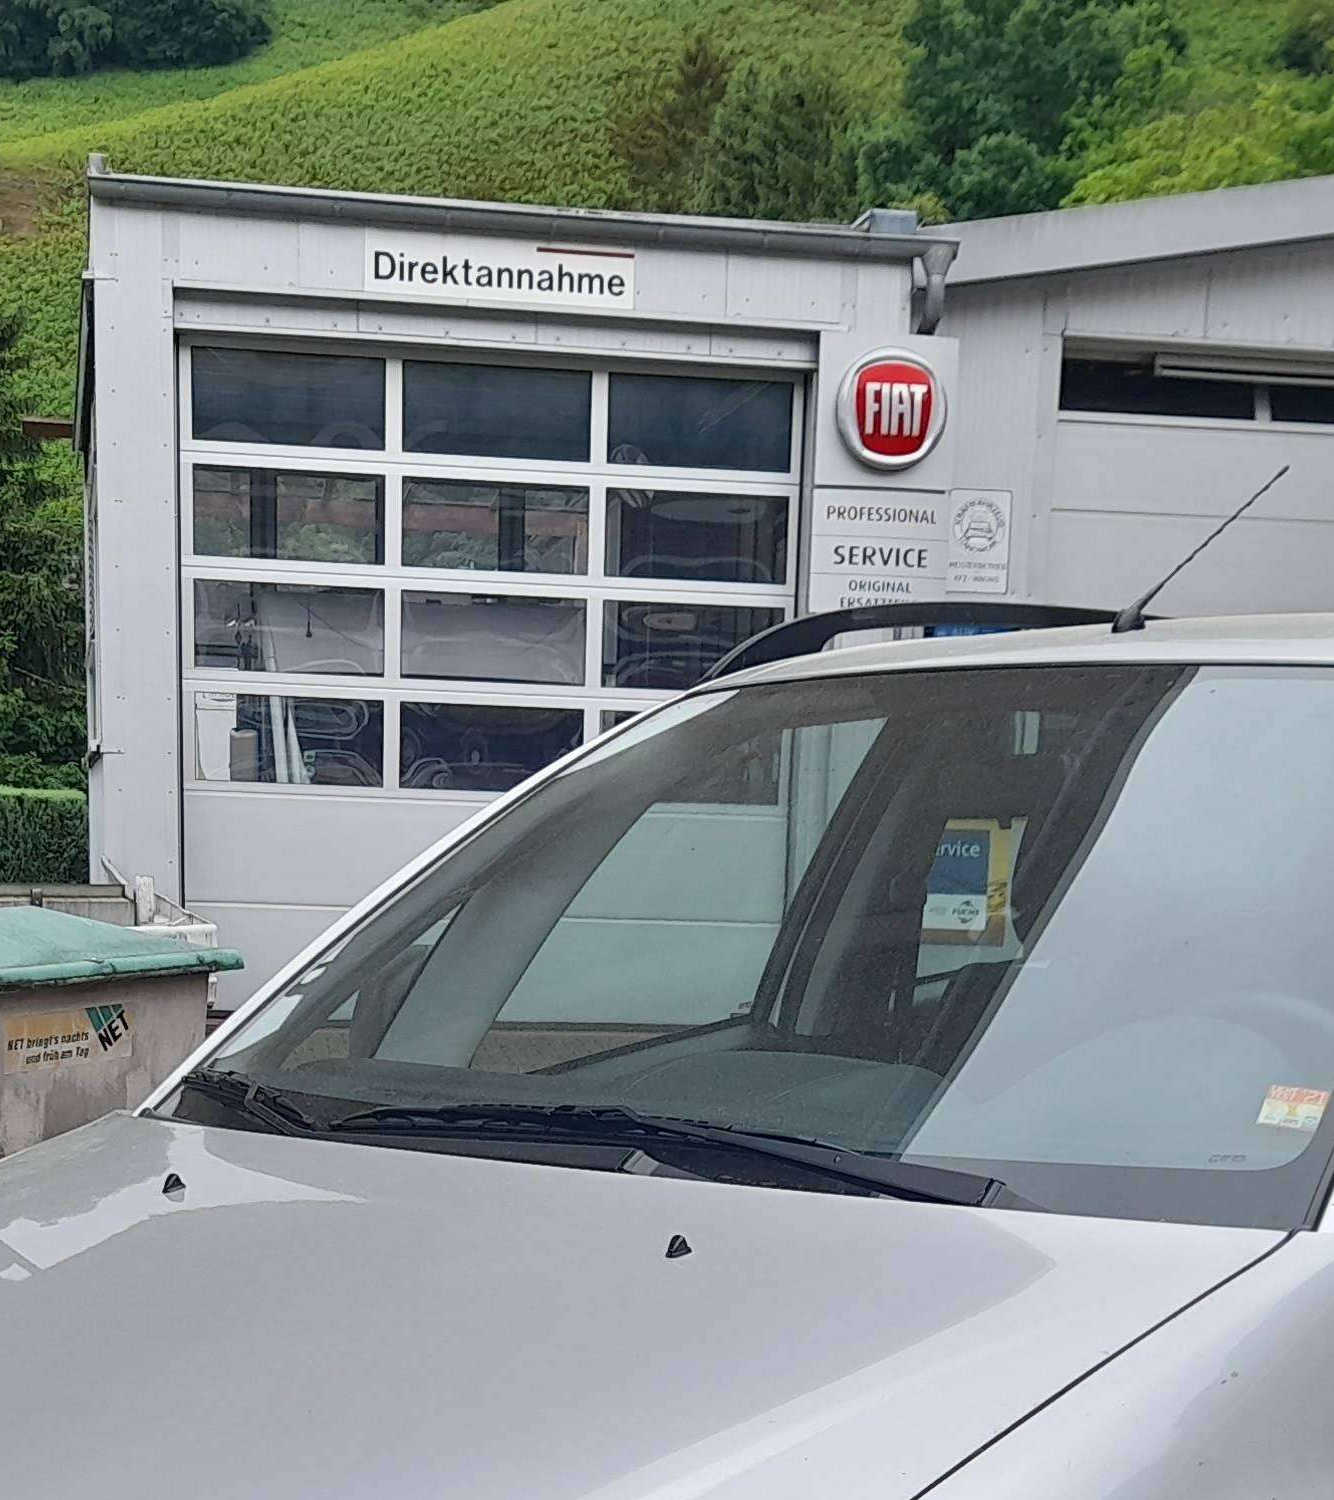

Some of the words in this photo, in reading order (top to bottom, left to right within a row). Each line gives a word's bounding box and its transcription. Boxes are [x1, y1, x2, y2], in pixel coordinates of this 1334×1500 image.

[373, 250, 626, 297] Direktannahme
[864, 381, 929, 438] FIAT
[826, 505, 937, 525] PROFESSIONAL
[832, 544, 928, 569] SERVICE
[848, 579, 912, 594] ORIGINAL
[98, 1009, 129, 1052] NET
